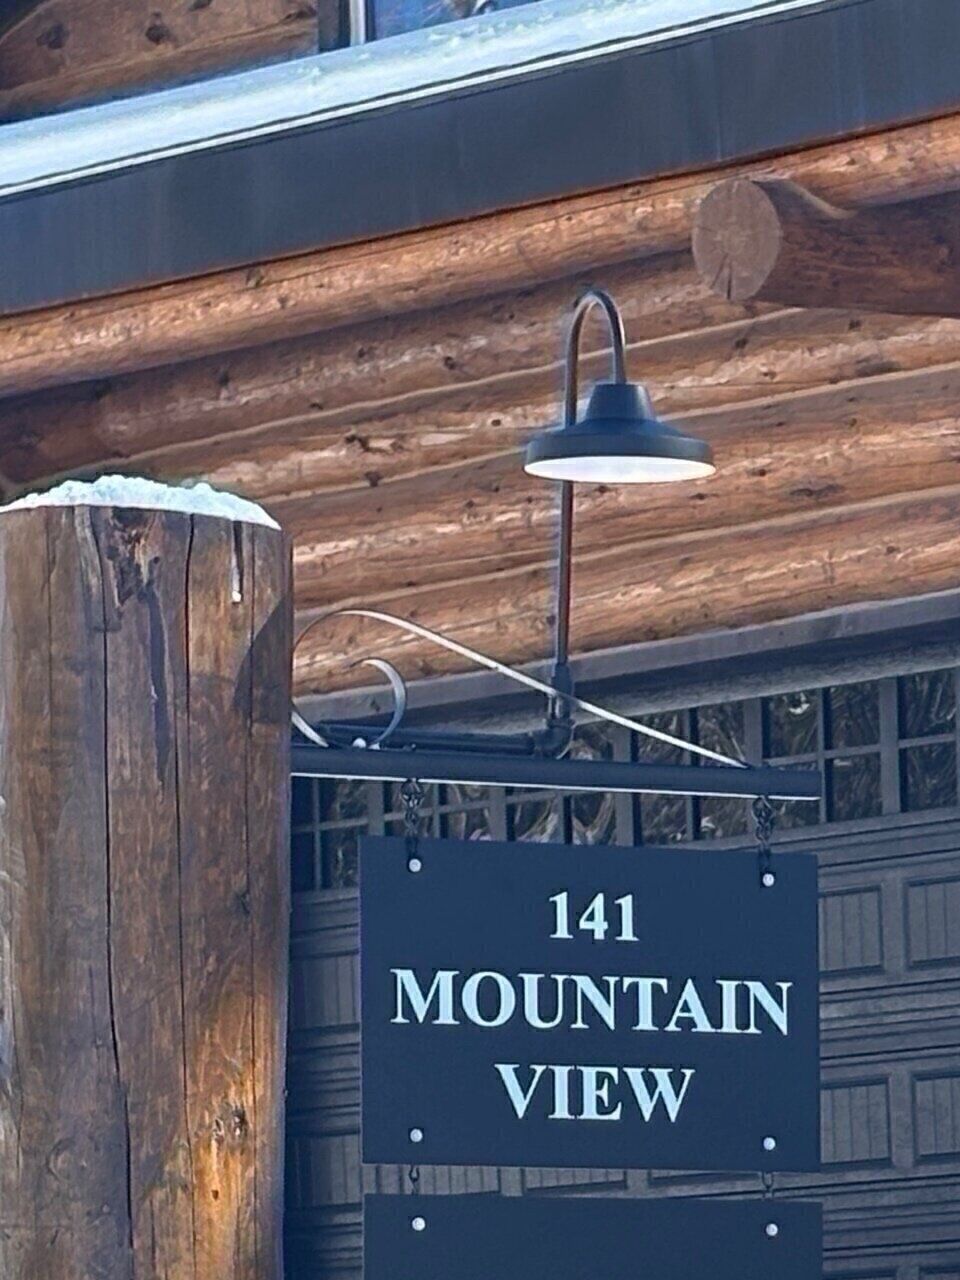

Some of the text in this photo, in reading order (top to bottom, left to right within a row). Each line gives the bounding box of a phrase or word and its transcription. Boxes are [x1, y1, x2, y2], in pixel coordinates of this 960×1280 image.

[549, 891, 639, 942] 141
[390, 968, 793, 1036] MOUNTAIN
[494, 1063, 696, 1123] VIEW
